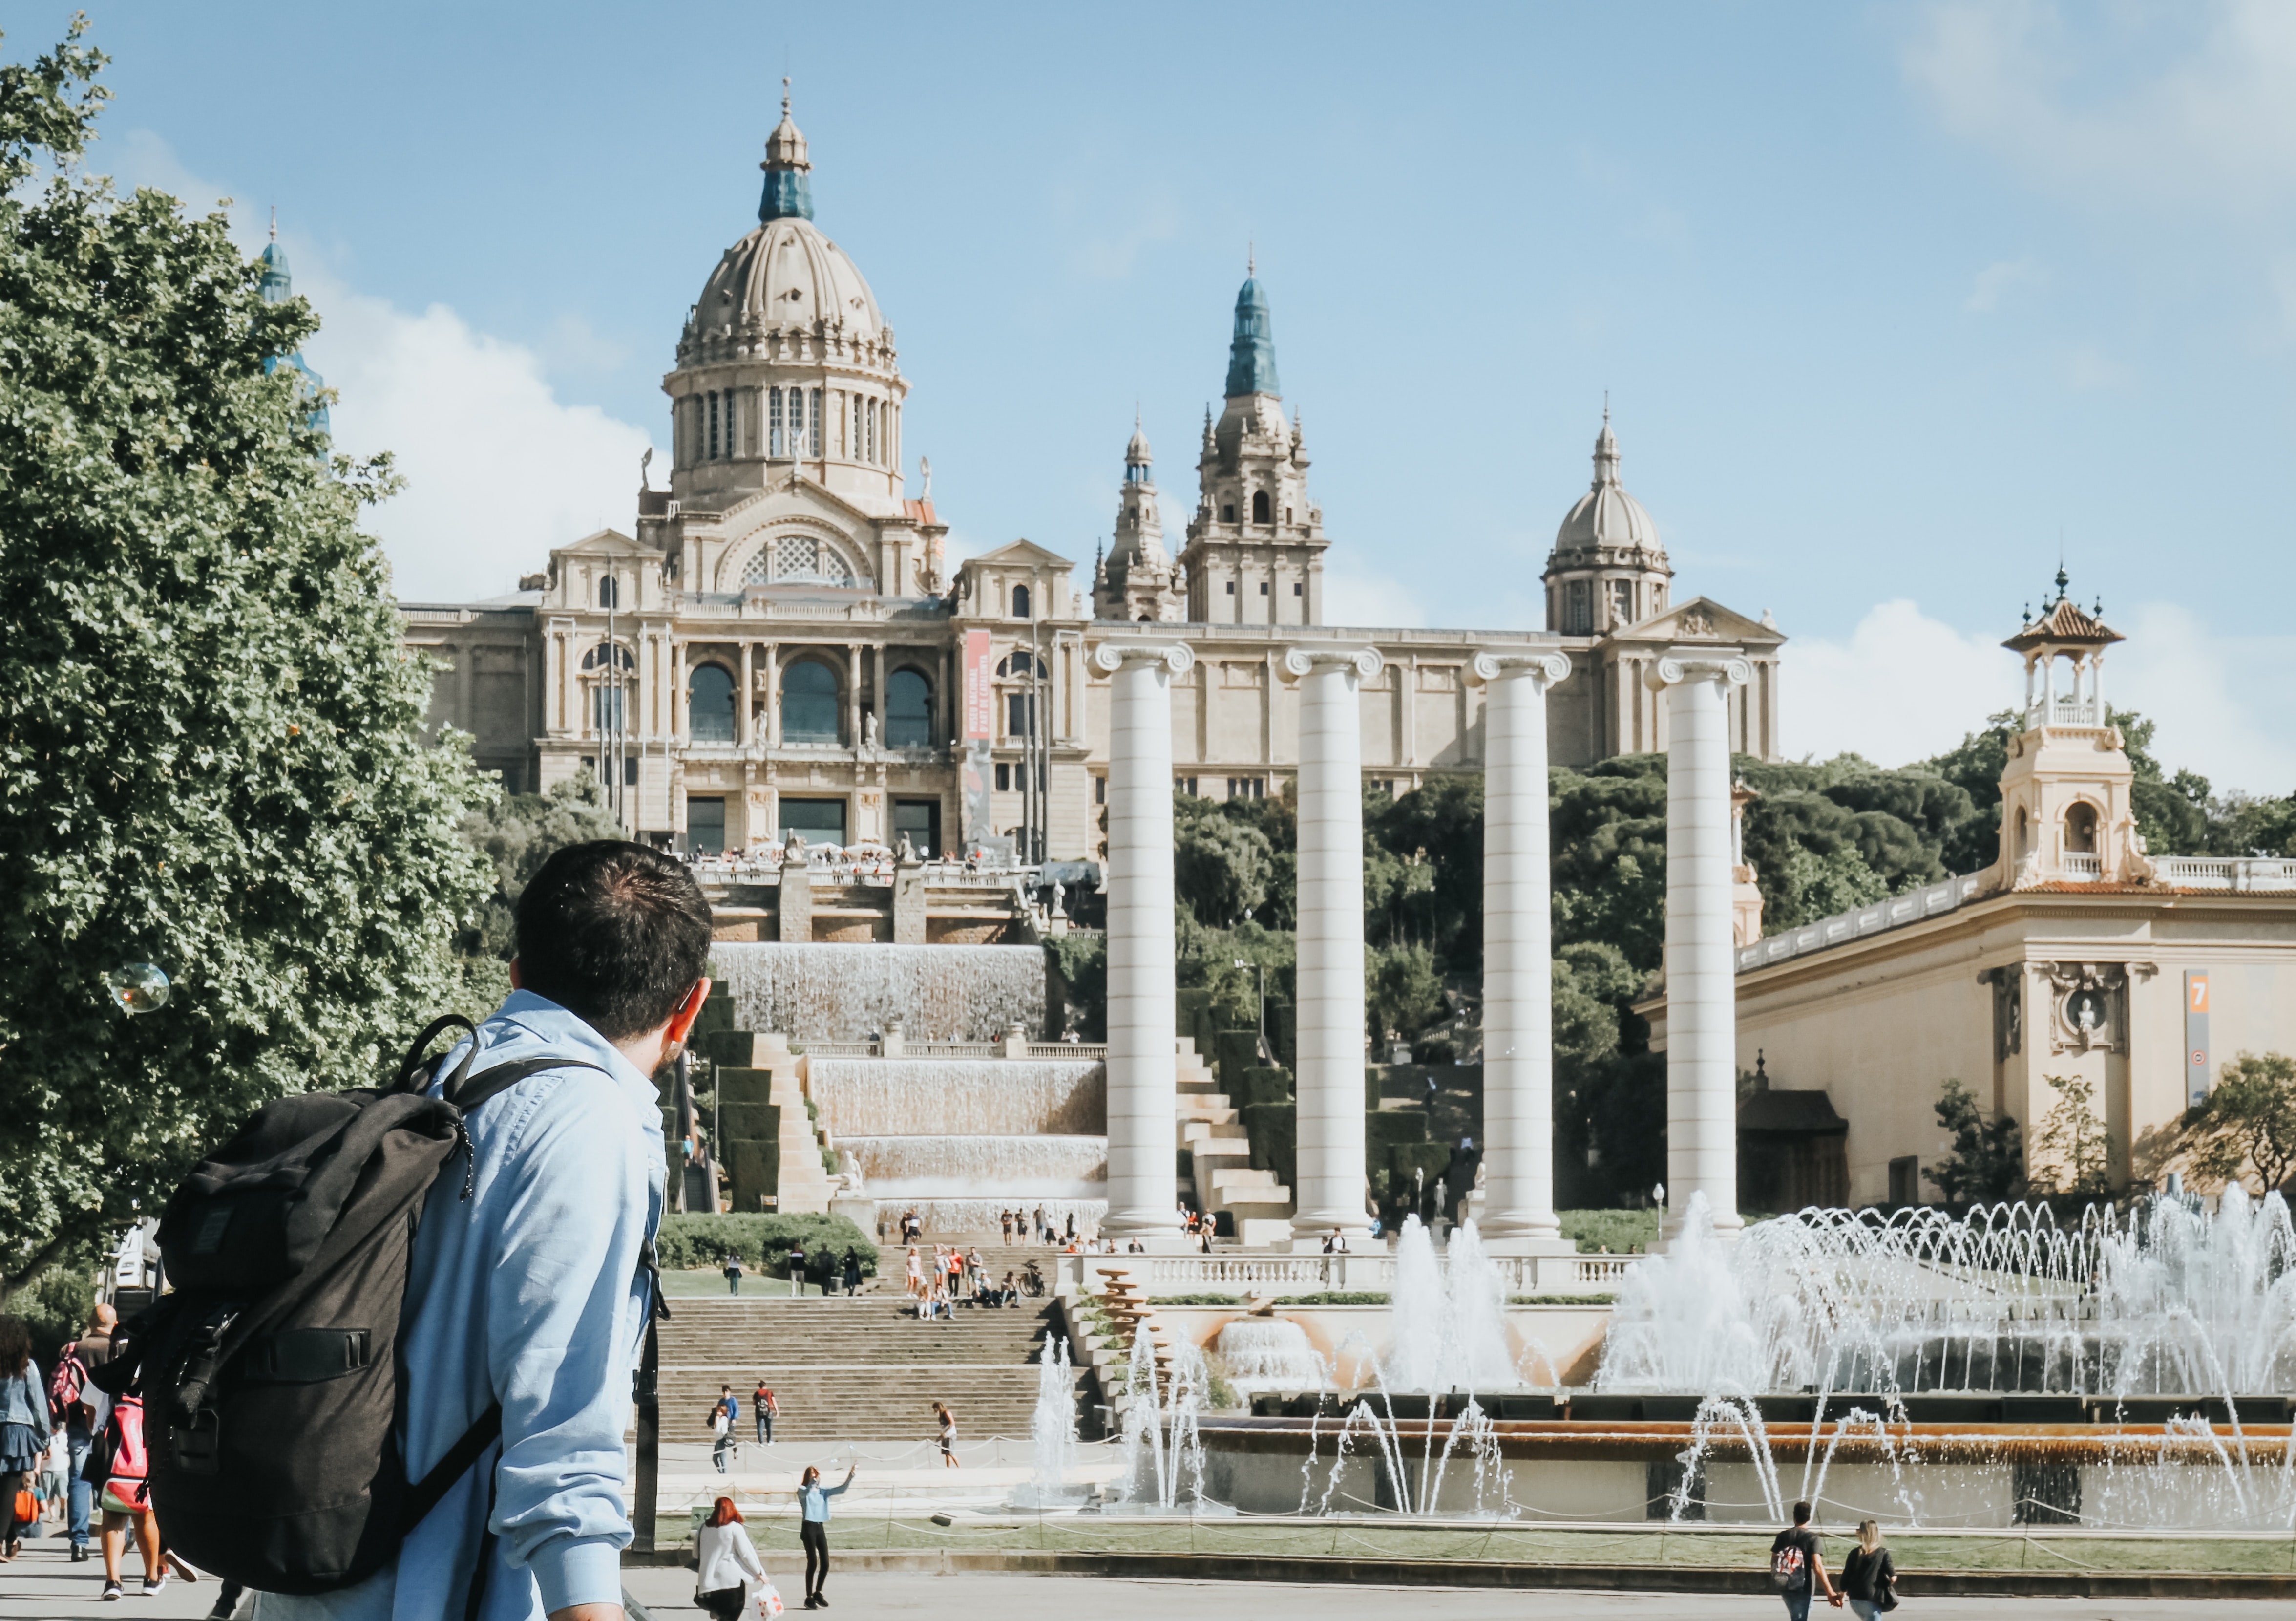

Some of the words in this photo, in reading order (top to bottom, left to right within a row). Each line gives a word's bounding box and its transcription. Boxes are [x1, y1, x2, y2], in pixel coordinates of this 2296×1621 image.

[969, 668, 978, 705] NACIONAL
[979, 654, 989, 697] CATALUNYA
[979, 699, 989, 709] DE
[969, 706, 978, 733] MUSEU
[979, 710, 989, 734] D'ART
[2192, 982, 2206, 1005] 7
